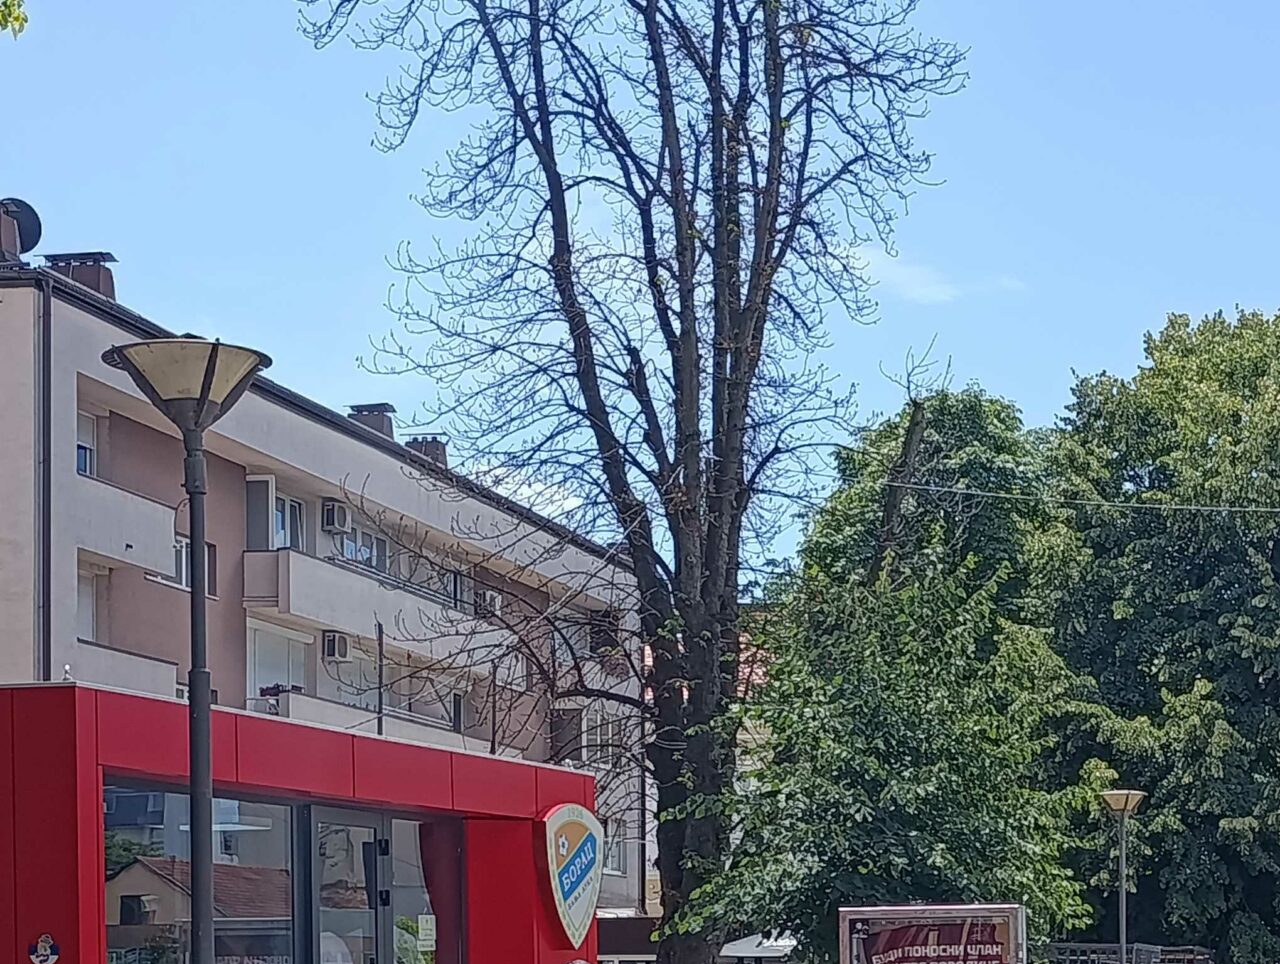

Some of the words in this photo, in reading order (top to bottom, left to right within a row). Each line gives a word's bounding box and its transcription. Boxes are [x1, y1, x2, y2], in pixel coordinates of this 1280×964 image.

[562, 842, 595, 892] БОРАЦ
[904, 944, 964, 957] ПОНОСНИ
[967, 944, 1002, 956] ЧЛАН
